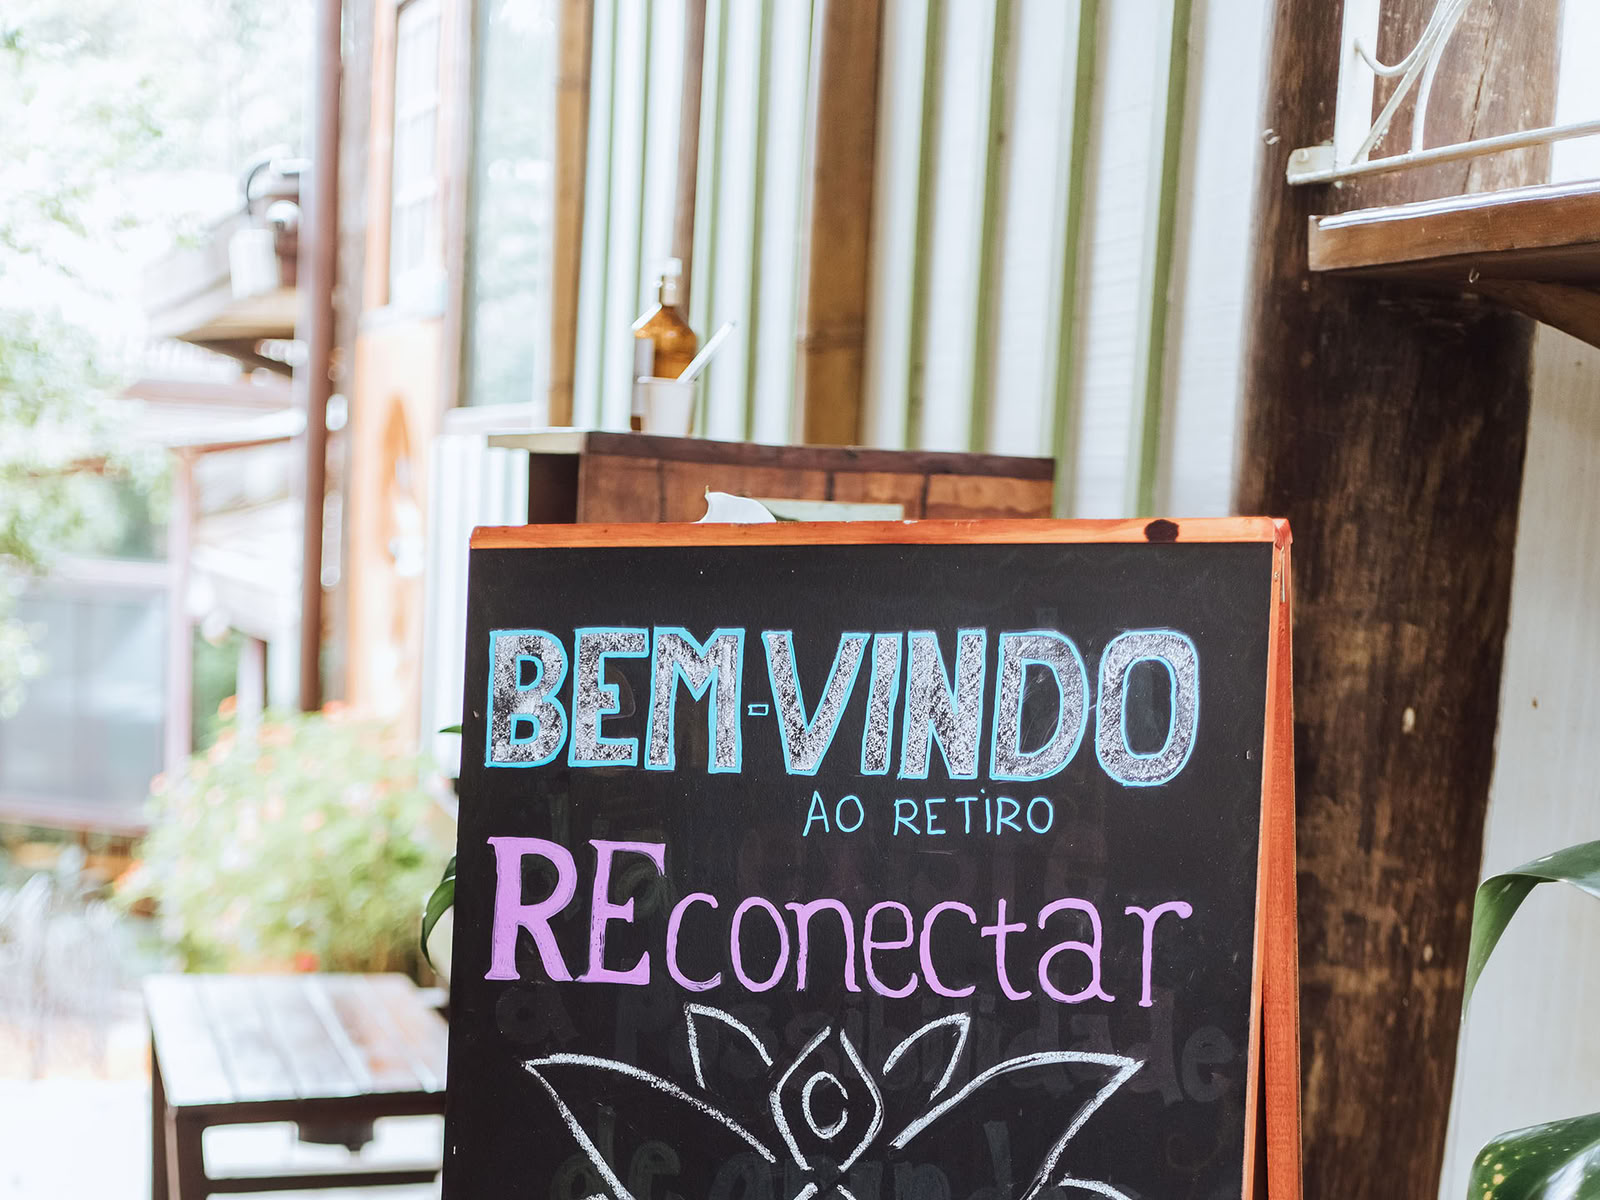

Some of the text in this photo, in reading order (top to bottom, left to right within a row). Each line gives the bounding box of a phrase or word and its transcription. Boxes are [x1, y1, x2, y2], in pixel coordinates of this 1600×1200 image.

[484, 626, 1201, 787] BEM-VINDO
[802, 786, 1056, 838] AO RETIRO
[483, 836, 1195, 1008] REconectar
